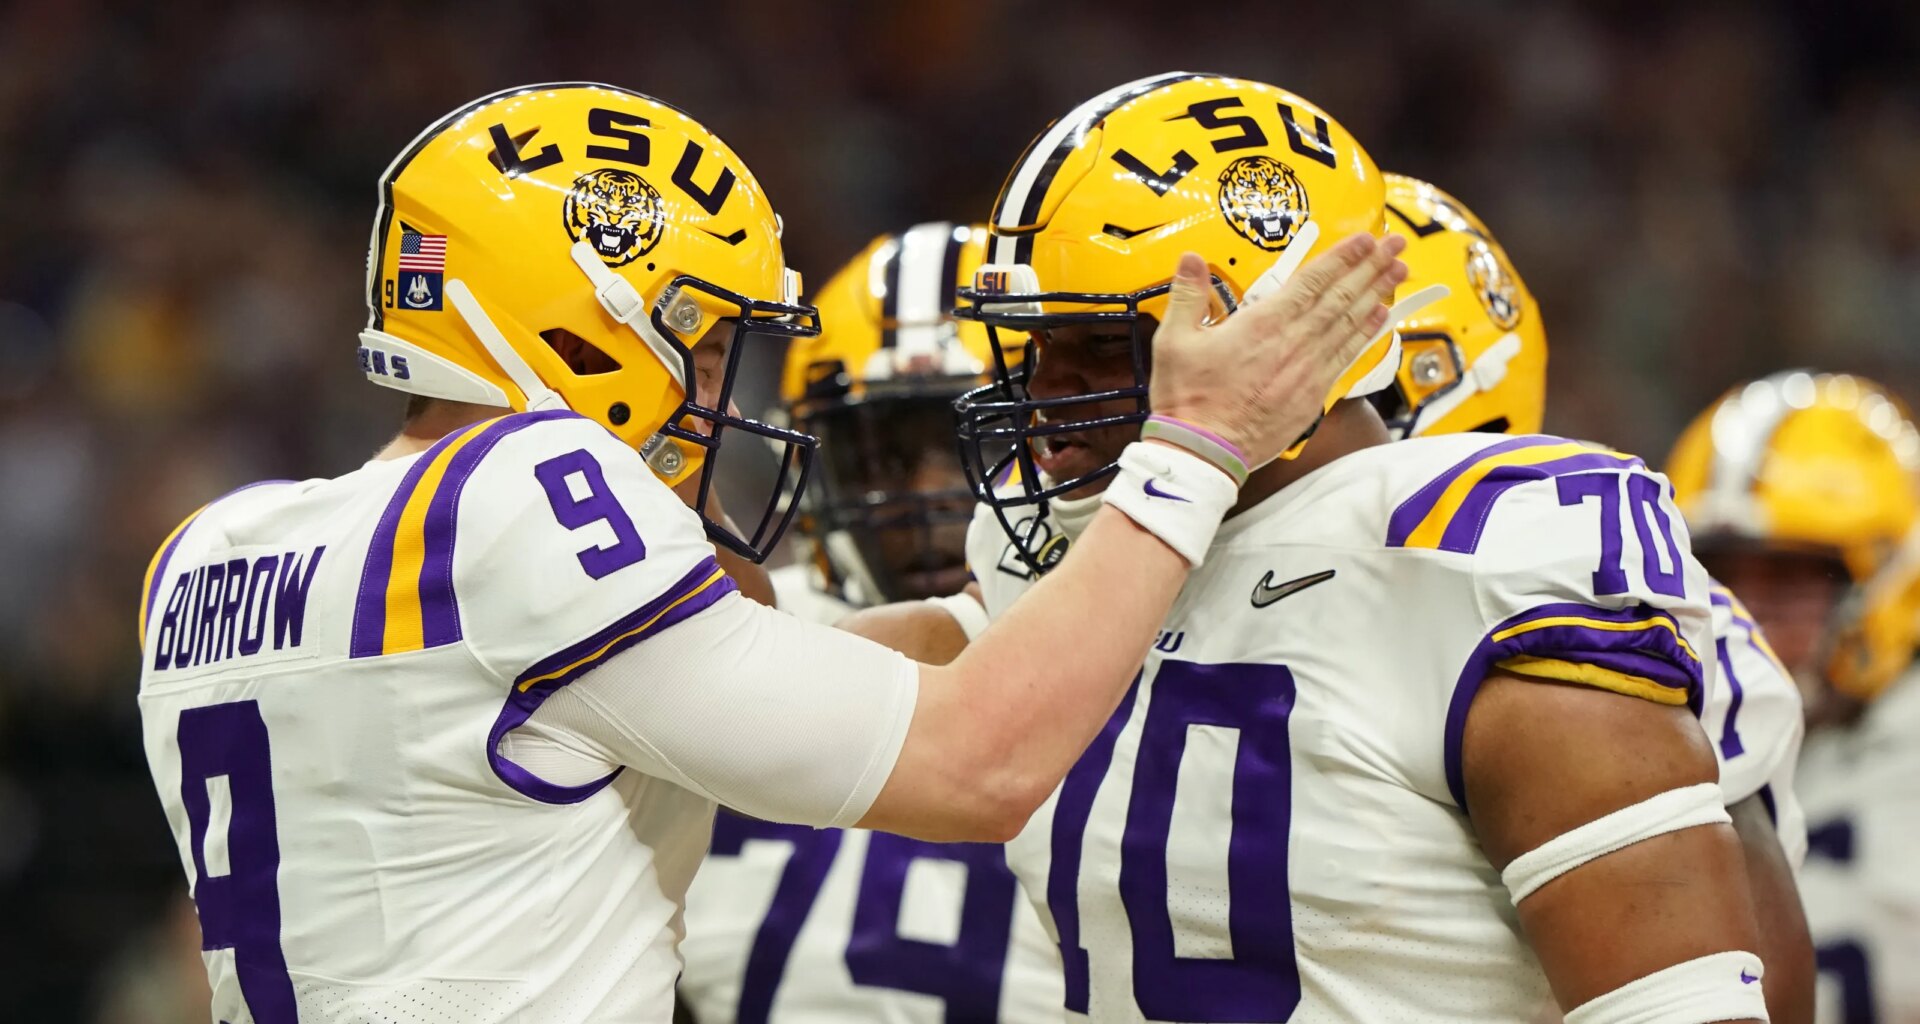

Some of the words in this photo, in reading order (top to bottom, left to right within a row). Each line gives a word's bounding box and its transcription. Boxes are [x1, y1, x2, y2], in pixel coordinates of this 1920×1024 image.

[488, 108, 736, 216] LSU
[1112, 97, 1336, 197] LSU
[386, 279, 394, 308] 9
[976, 272, 1006, 294] LSU
[535, 448, 646, 580] 9
[1555, 471, 1684, 598] 70
[153, 545, 326, 671] BURROW
[177, 699, 299, 1024] 9
